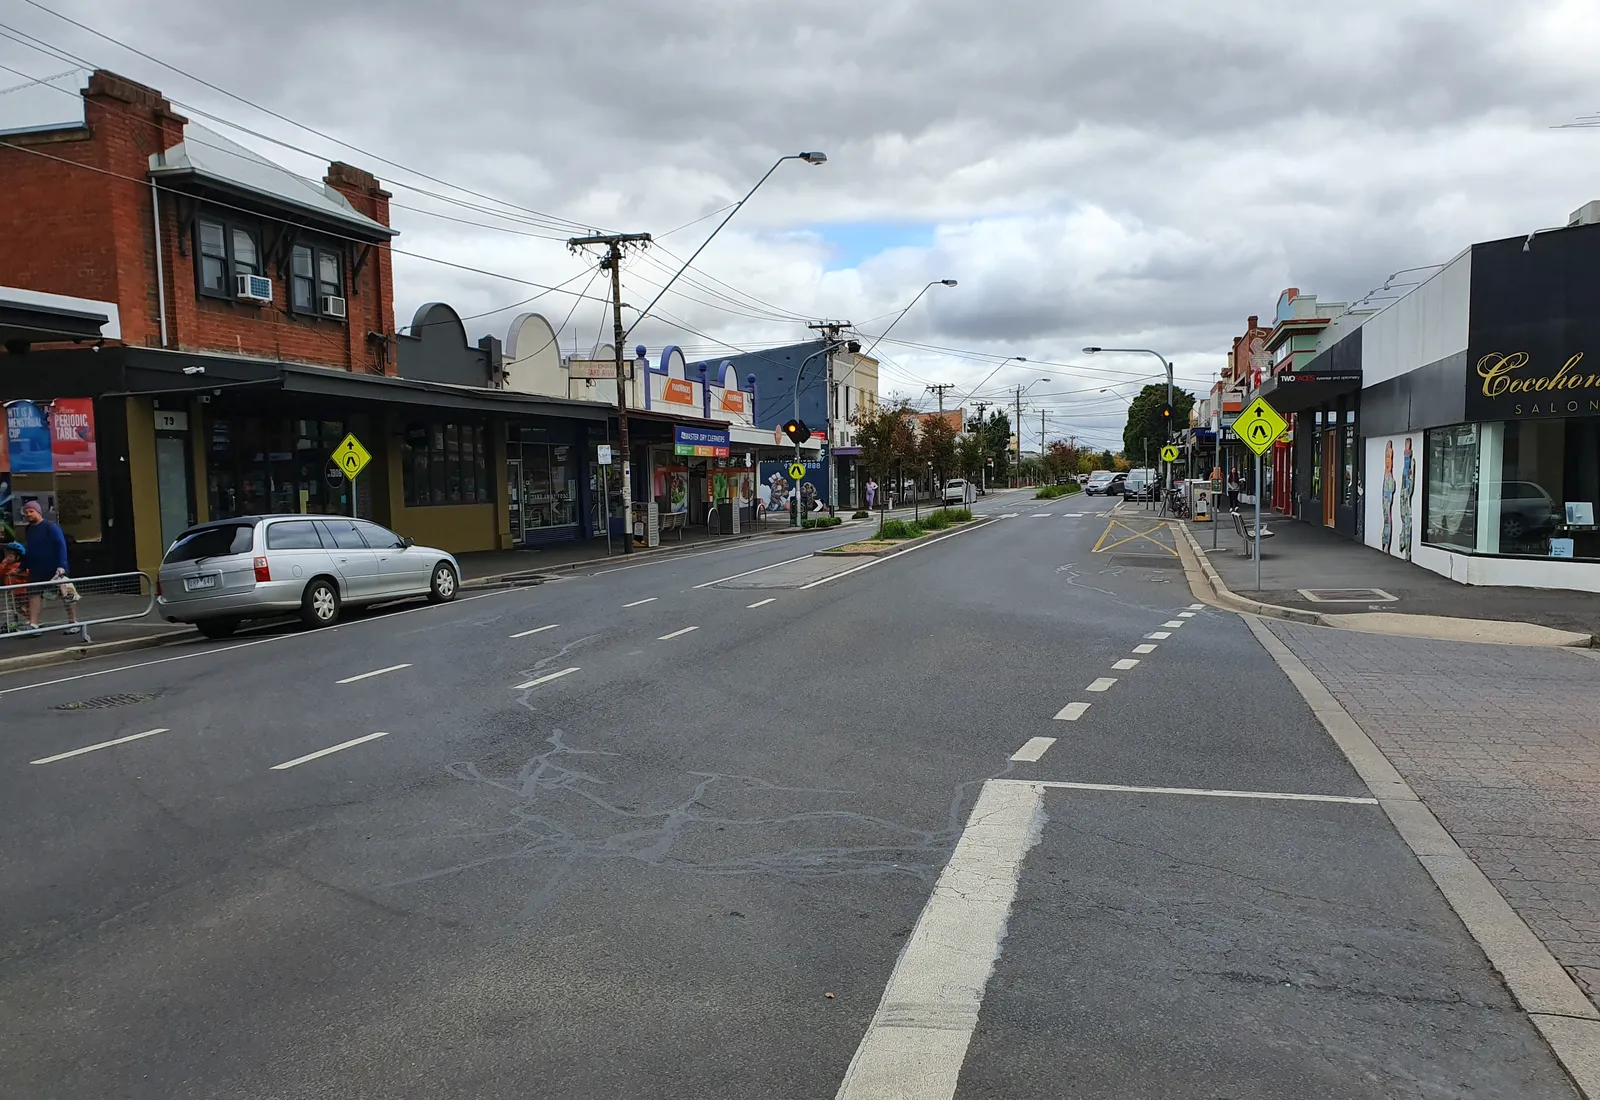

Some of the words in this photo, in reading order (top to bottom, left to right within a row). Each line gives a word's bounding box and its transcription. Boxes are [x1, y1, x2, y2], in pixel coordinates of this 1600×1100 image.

[21, 406, 27, 417] IS
[28, 406, 33, 417] A
[1515, 400, 1599, 414] SALON
[8, 417, 42, 428] MENSTRUAL
[54, 414, 88, 426] PERIODIC
[164, 417, 174, 425] 79
[9, 428, 20, 438] CUP
[56, 427, 78, 440] TABLE
